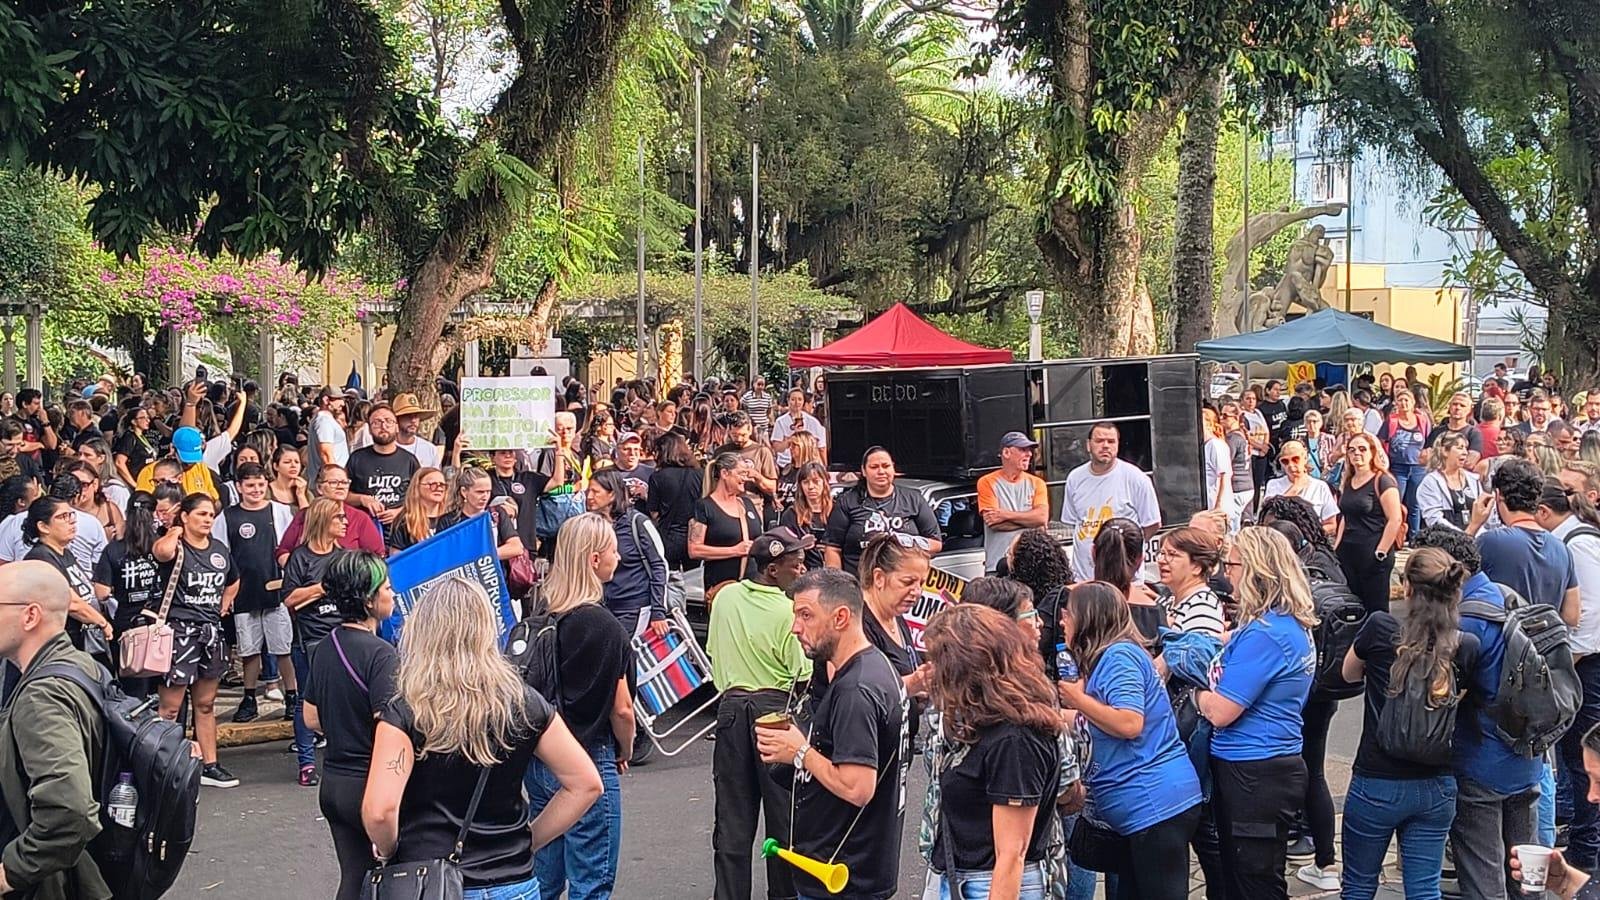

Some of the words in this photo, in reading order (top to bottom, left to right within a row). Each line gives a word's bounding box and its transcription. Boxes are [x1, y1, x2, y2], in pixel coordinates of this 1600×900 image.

[462, 387, 551, 402] PROFESSOR
[368, 475, 402, 489] LUTO
[187, 572, 225, 587] LUTO
